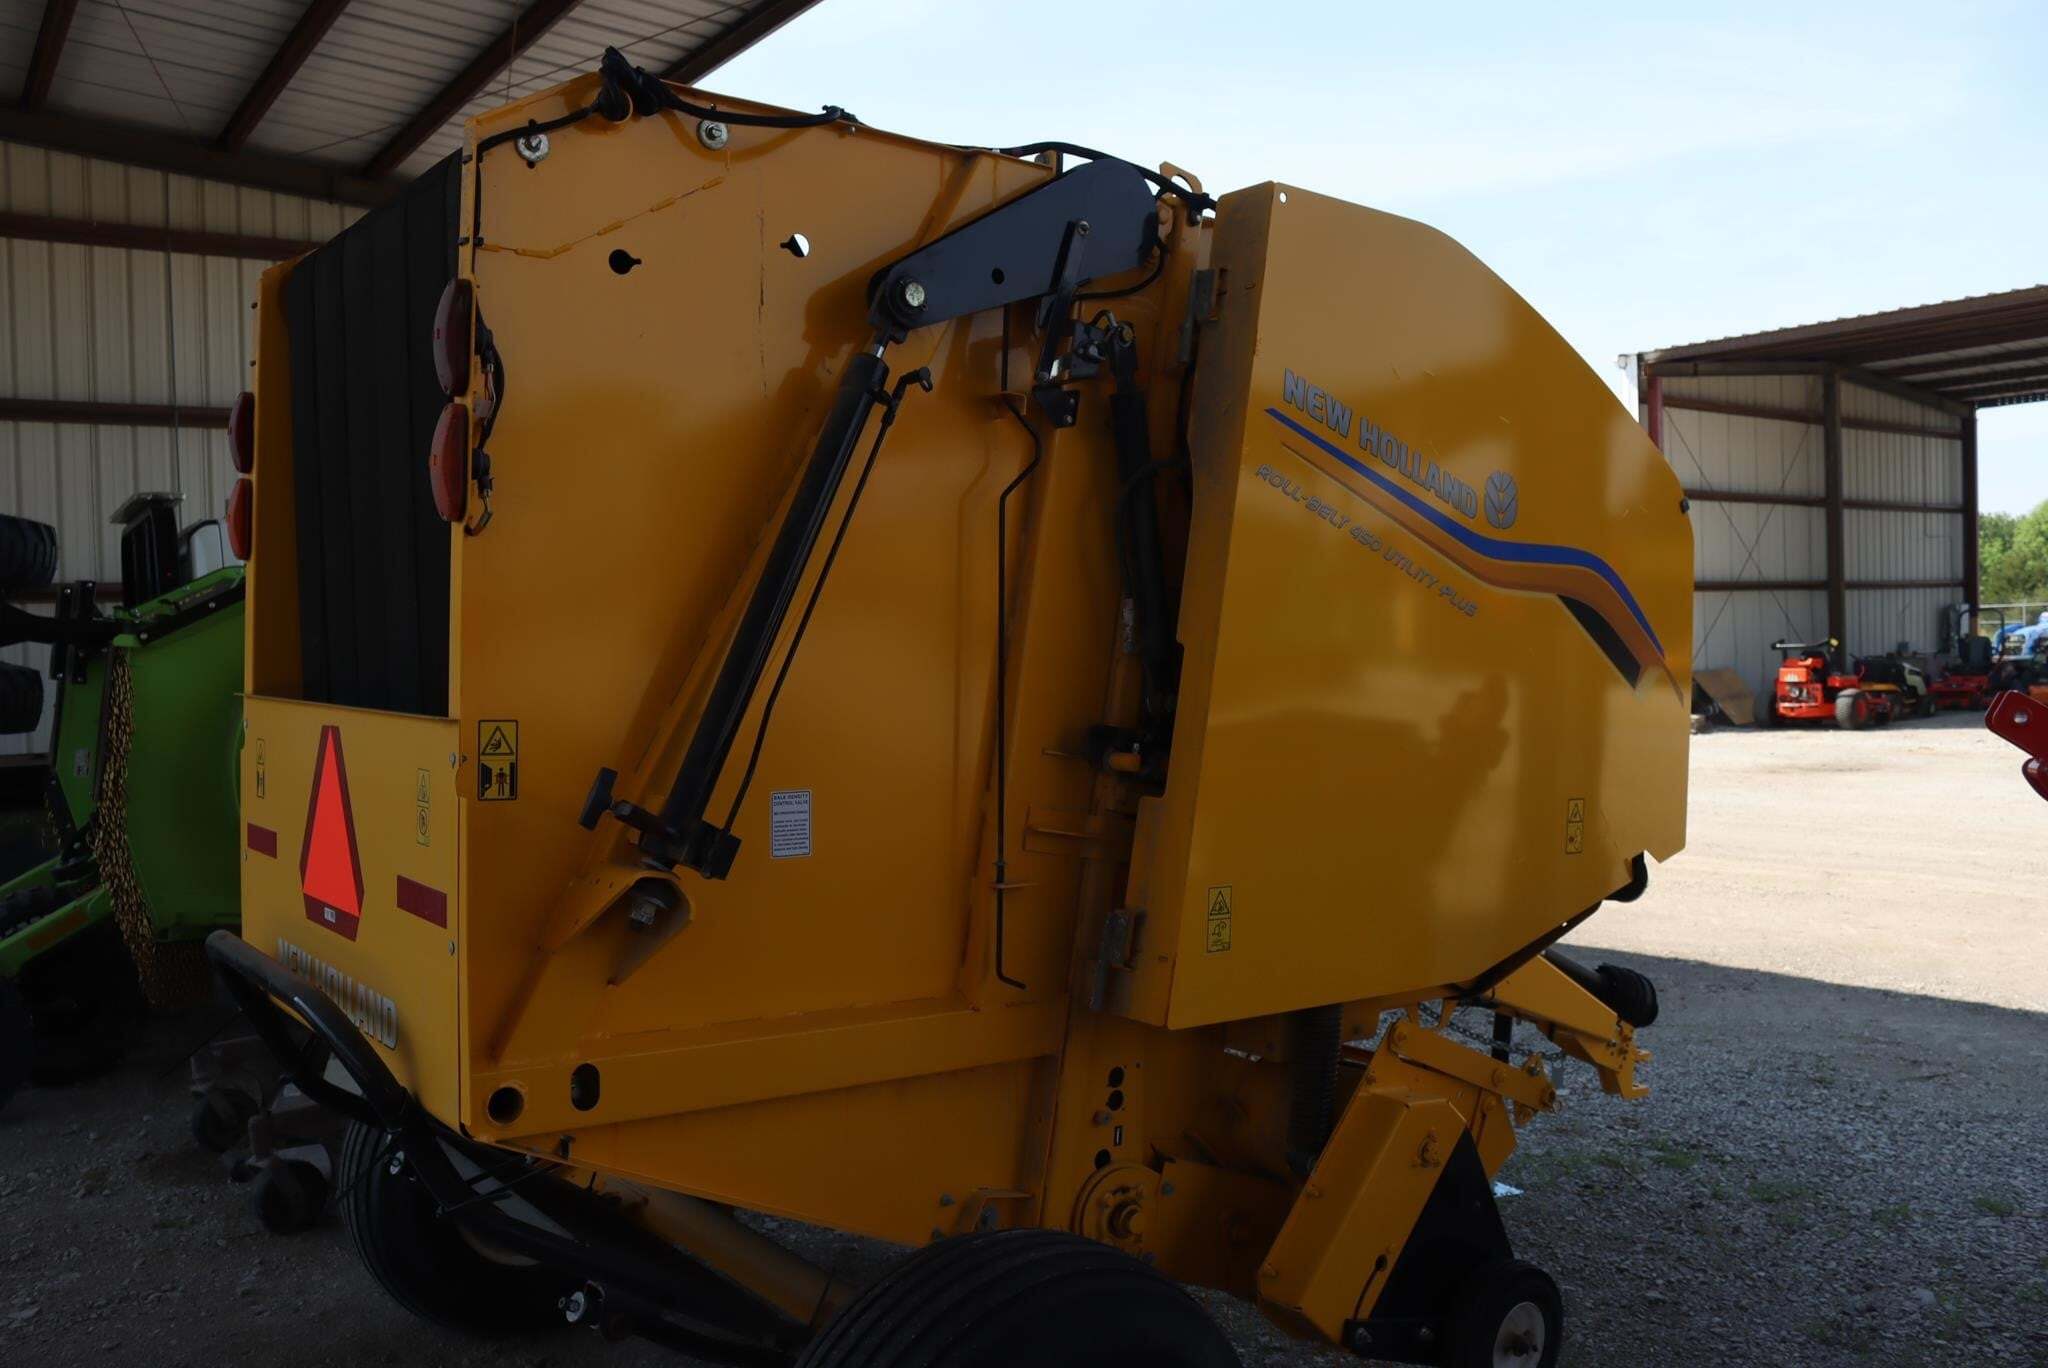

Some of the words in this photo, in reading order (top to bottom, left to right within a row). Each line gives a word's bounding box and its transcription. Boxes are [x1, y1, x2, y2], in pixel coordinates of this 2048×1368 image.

[1283, 368, 1353, 438] NEW
[1359, 416, 1478, 519] HOLLAND
[1255, 463, 1351, 530] ROLL-BELT
[1350, 525, 1383, 553] 450
[1383, 548, 1440, 589] UTILITY
[1438, 584, 1479, 618] PLUS
